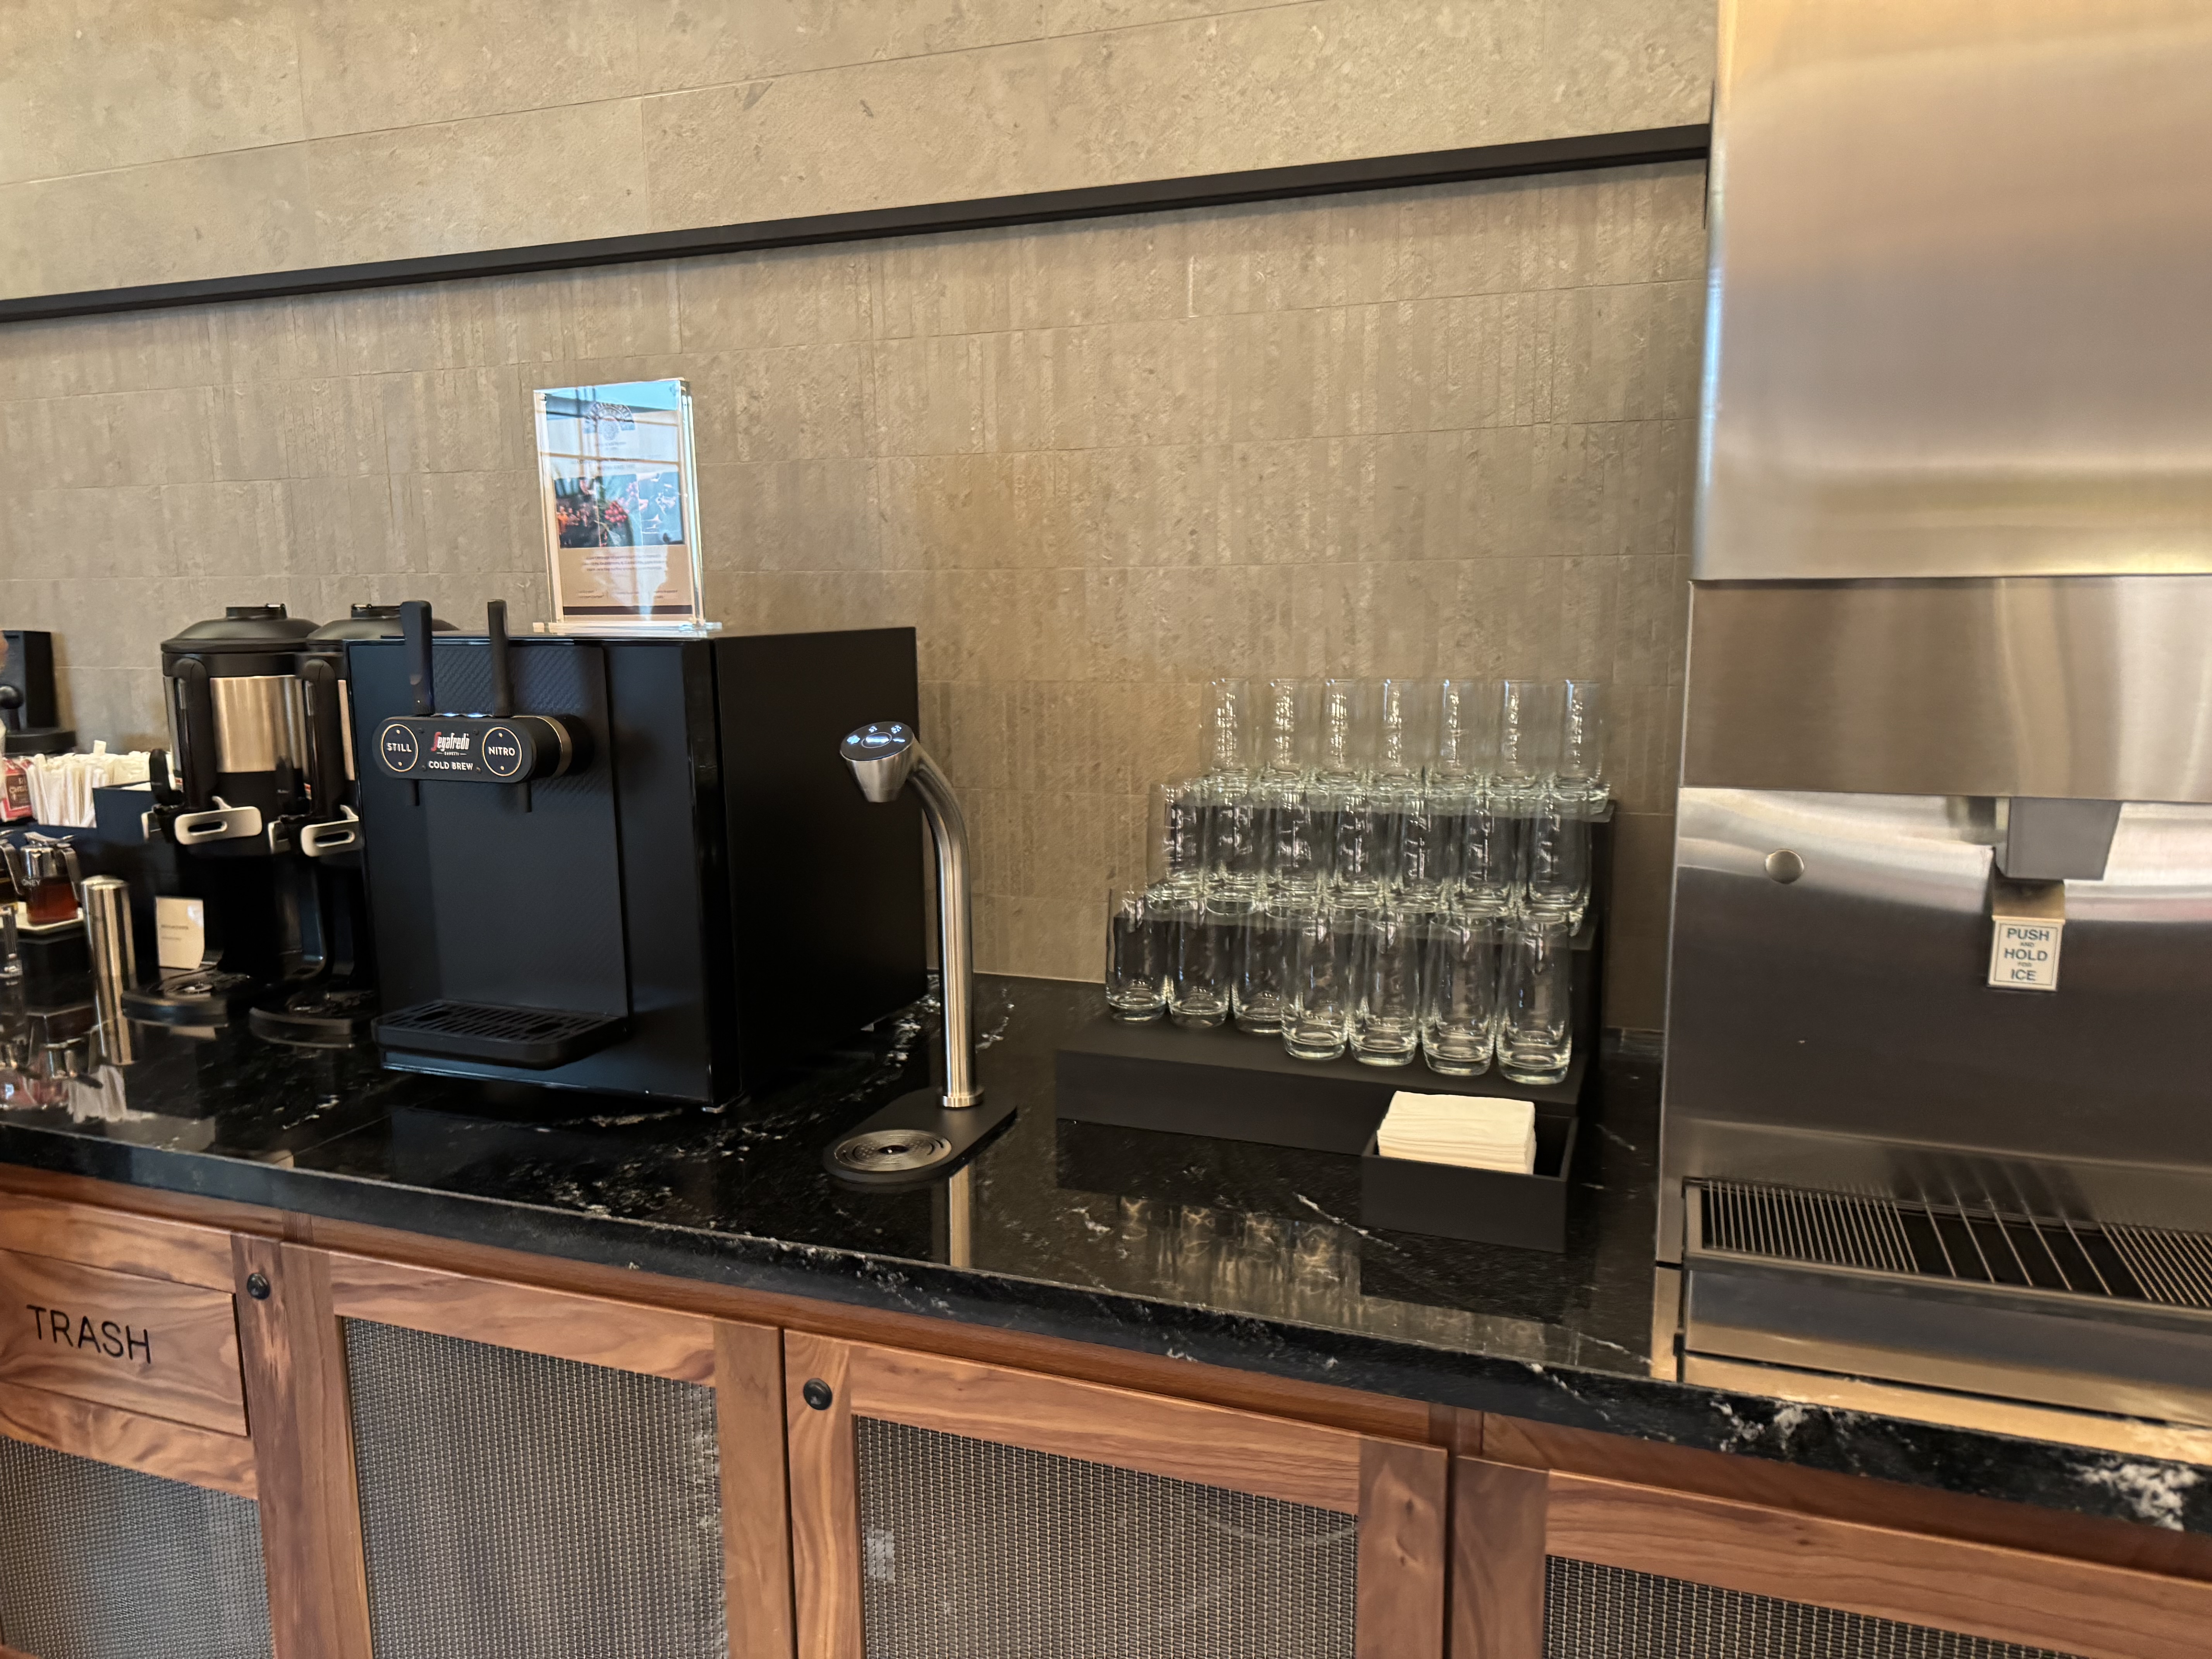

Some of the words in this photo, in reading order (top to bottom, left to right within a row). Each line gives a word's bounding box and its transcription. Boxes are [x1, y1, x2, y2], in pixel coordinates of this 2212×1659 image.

[386, 742, 412, 752] STILL
[431, 732, 470, 752] Segafredo
[488, 746, 515, 756] NITRO
[428, 760, 450, 769] COLD
[452, 761, 473, 771] BREW
[2007, 927, 2050, 941] PUSH
[2004, 948, 2048, 962] HOLD
[2011, 969, 2037, 981] ICE
[26, 1304, 151, 1364] TRASH
